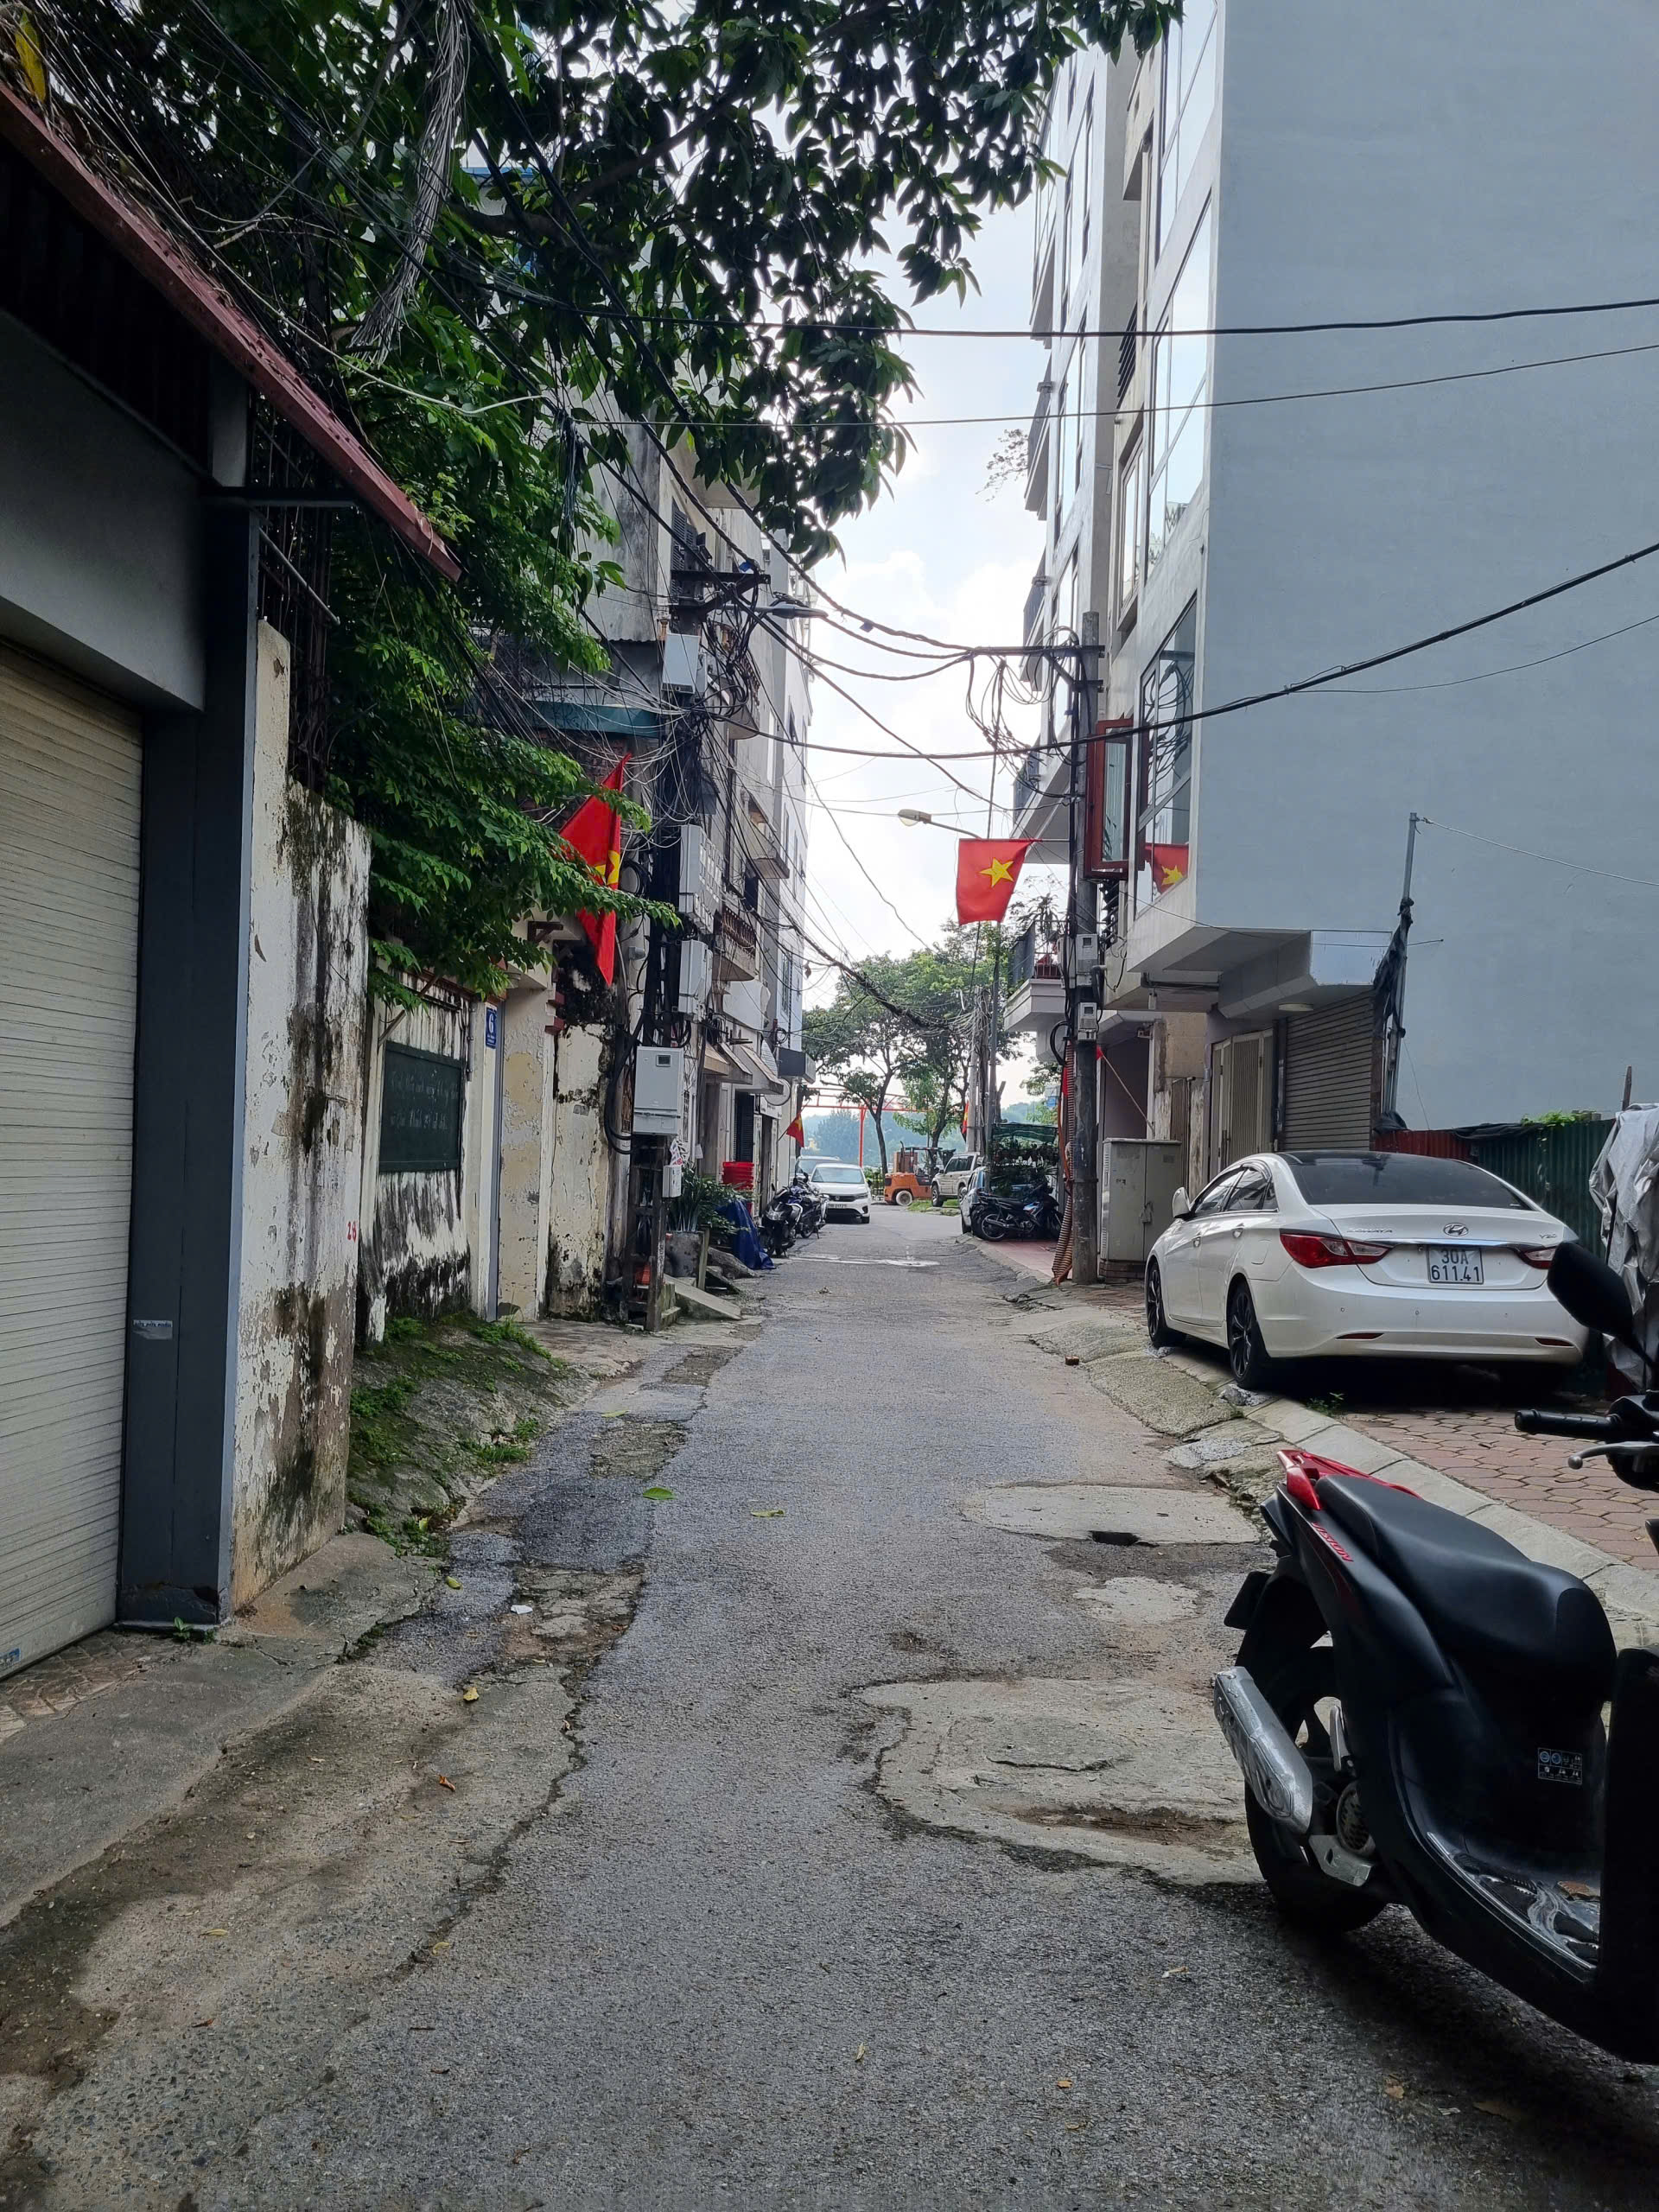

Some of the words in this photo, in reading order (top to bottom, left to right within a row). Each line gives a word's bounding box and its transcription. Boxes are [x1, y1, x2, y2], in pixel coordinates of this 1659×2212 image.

[488, 1014, 494, 1033] 6
[1440, 1249, 1469, 1264] 30A
[1431, 1264, 1480, 1281] 611.41
